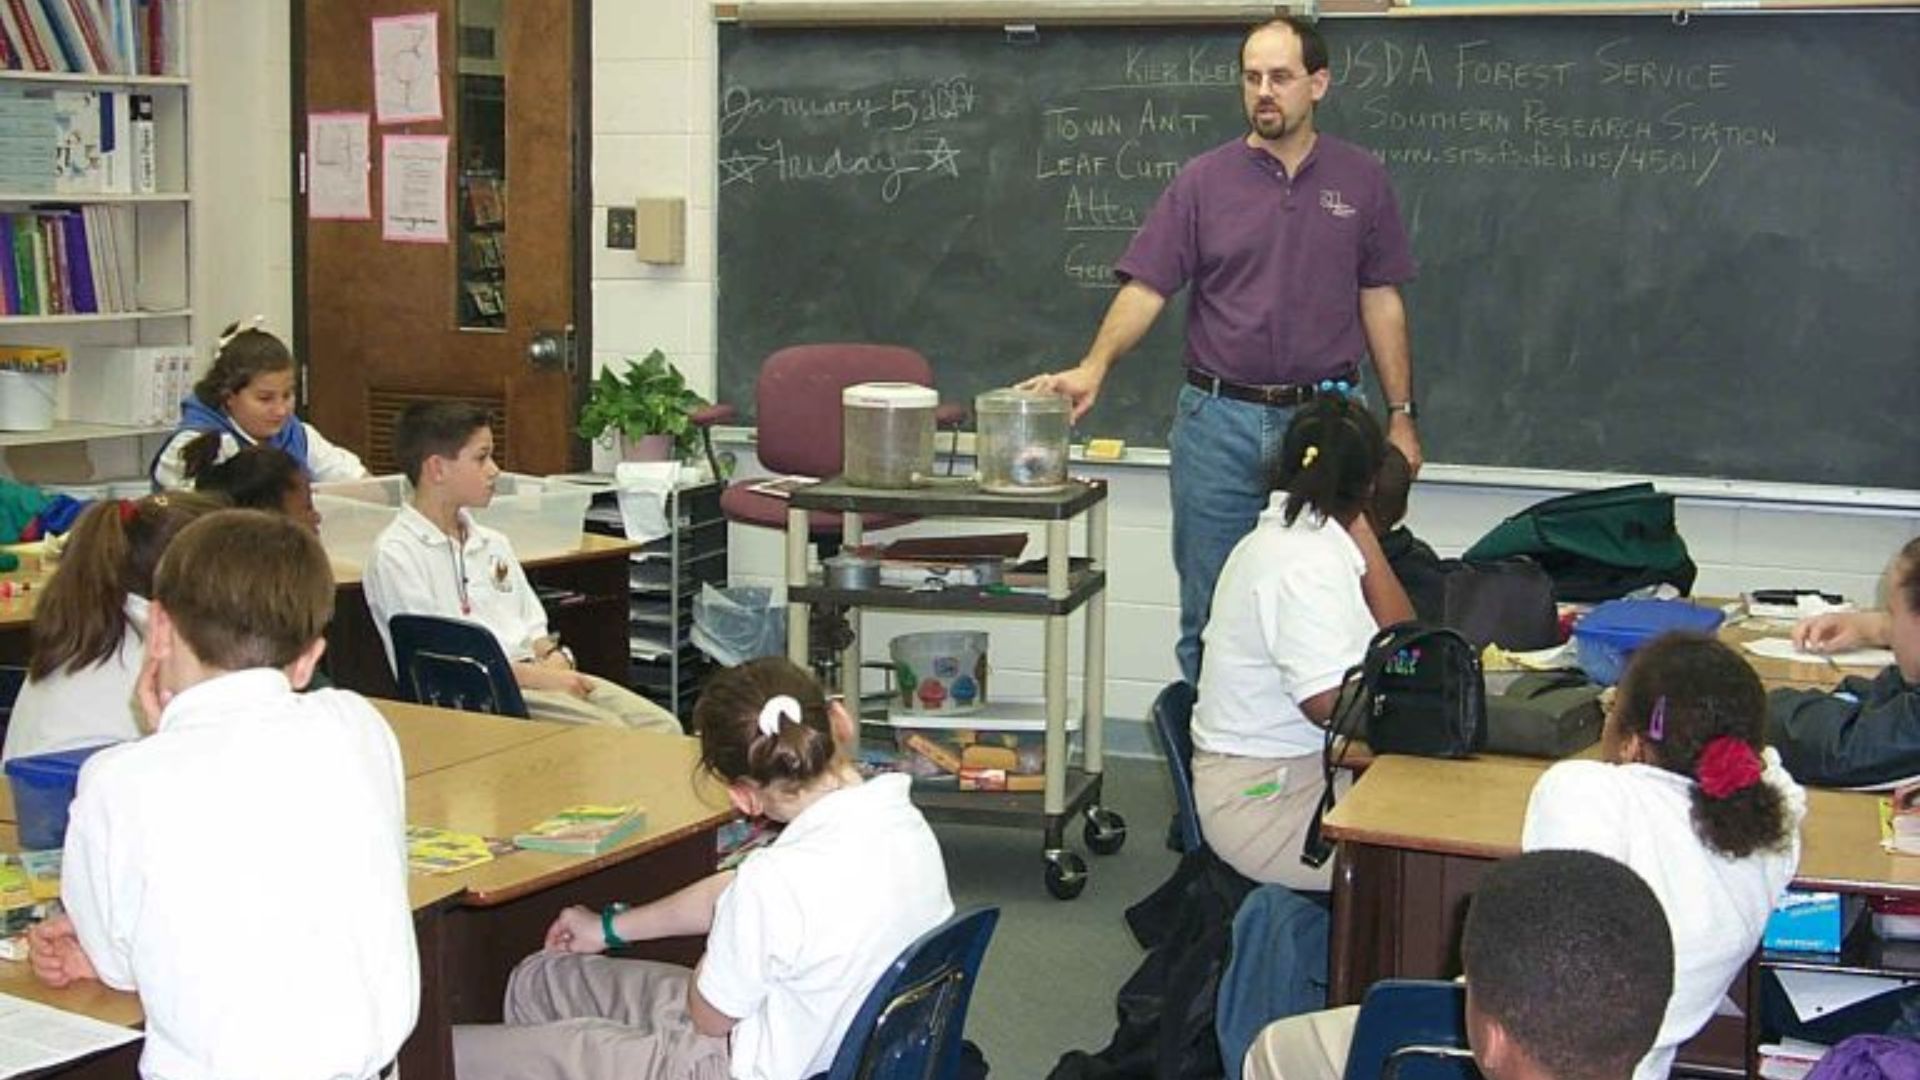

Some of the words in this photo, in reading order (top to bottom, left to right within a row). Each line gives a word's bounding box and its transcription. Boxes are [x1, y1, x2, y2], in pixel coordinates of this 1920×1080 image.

[1454, 40, 1577, 90] FOREST
[1596, 37, 1736, 90] SERVICE
[892, 89, 917, 131] 5
[1043, 106, 1121, 140] TOWN
[1139, 98, 1210, 137] ANT
[1360, 95, 1509, 133] SOUTHERN
[1523, 99, 1650, 138] RESEARCH
[1660, 102, 1777, 145] STATION
[757, 138, 921, 203] Friday
[1036, 151, 1108, 179] LEAF
